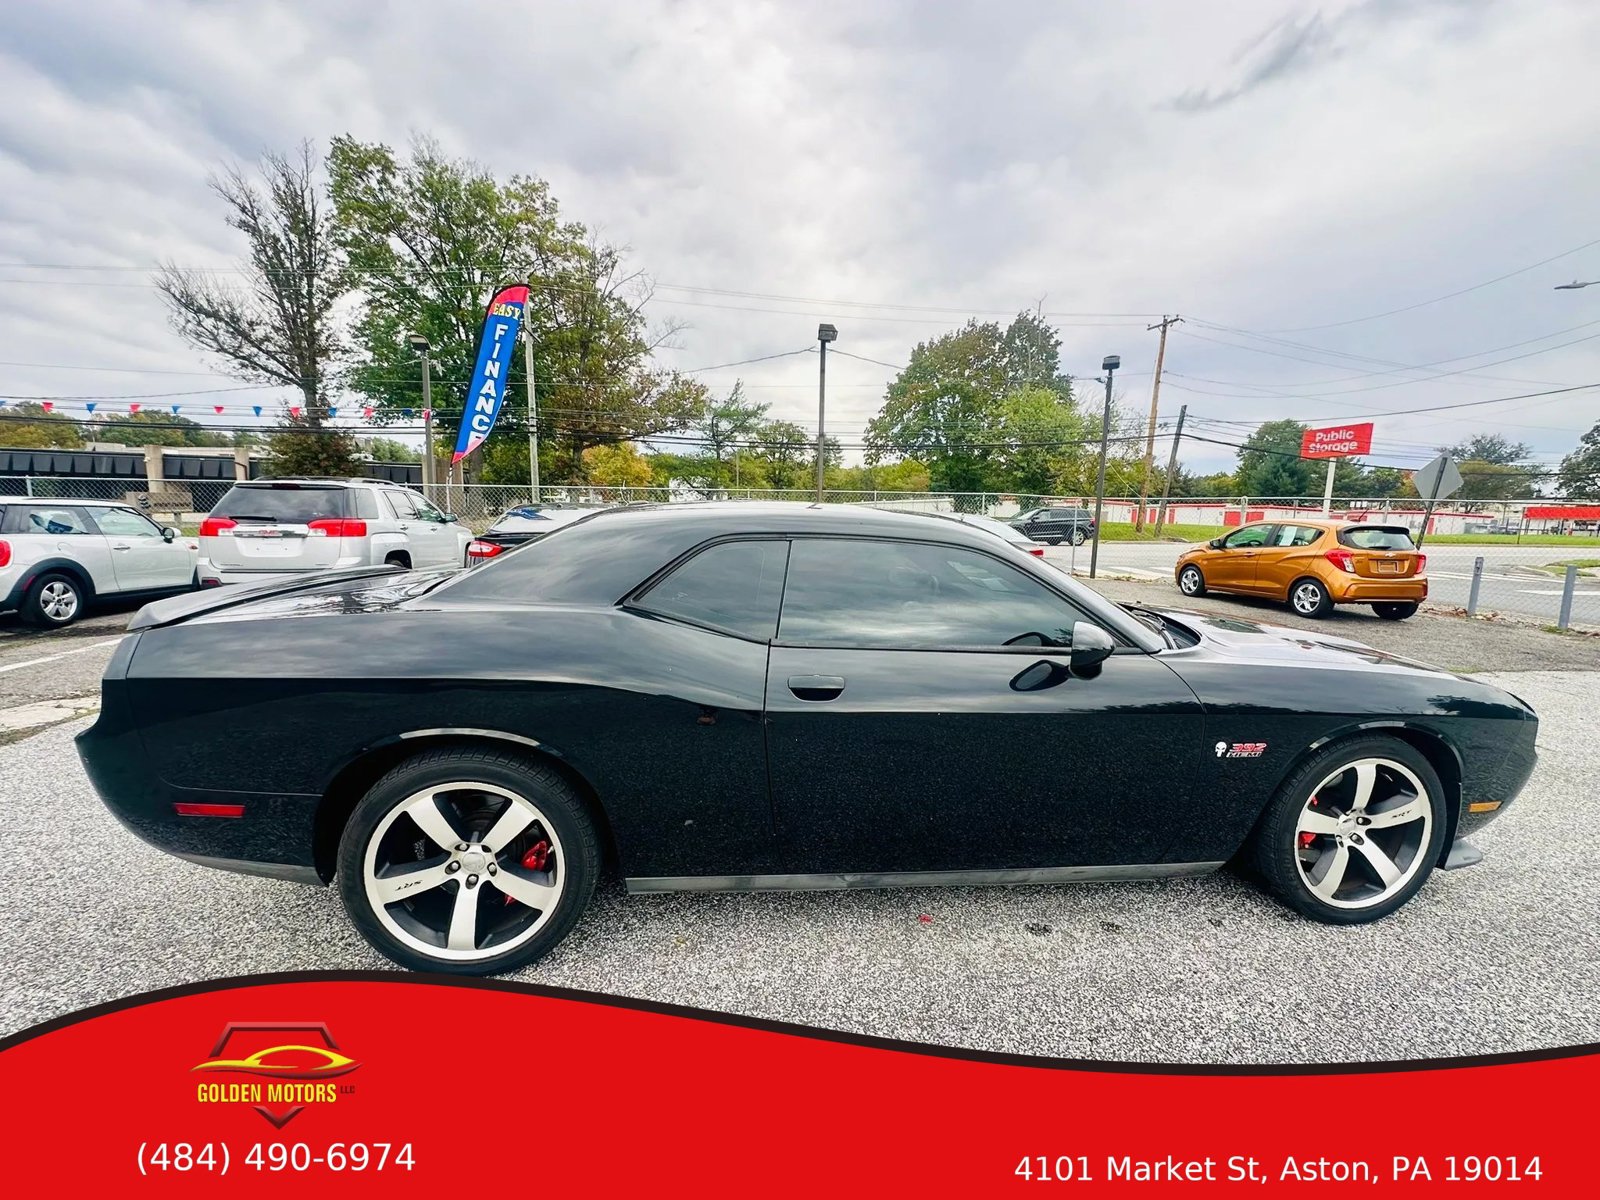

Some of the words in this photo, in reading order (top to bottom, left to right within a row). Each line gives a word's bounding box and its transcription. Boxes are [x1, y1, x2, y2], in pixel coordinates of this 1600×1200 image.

[493, 302, 522, 320] EASY
[1315, 429, 1355, 442] Public
[1308, 441, 1358, 454] Storage
[1229, 742, 1267, 752] 392
